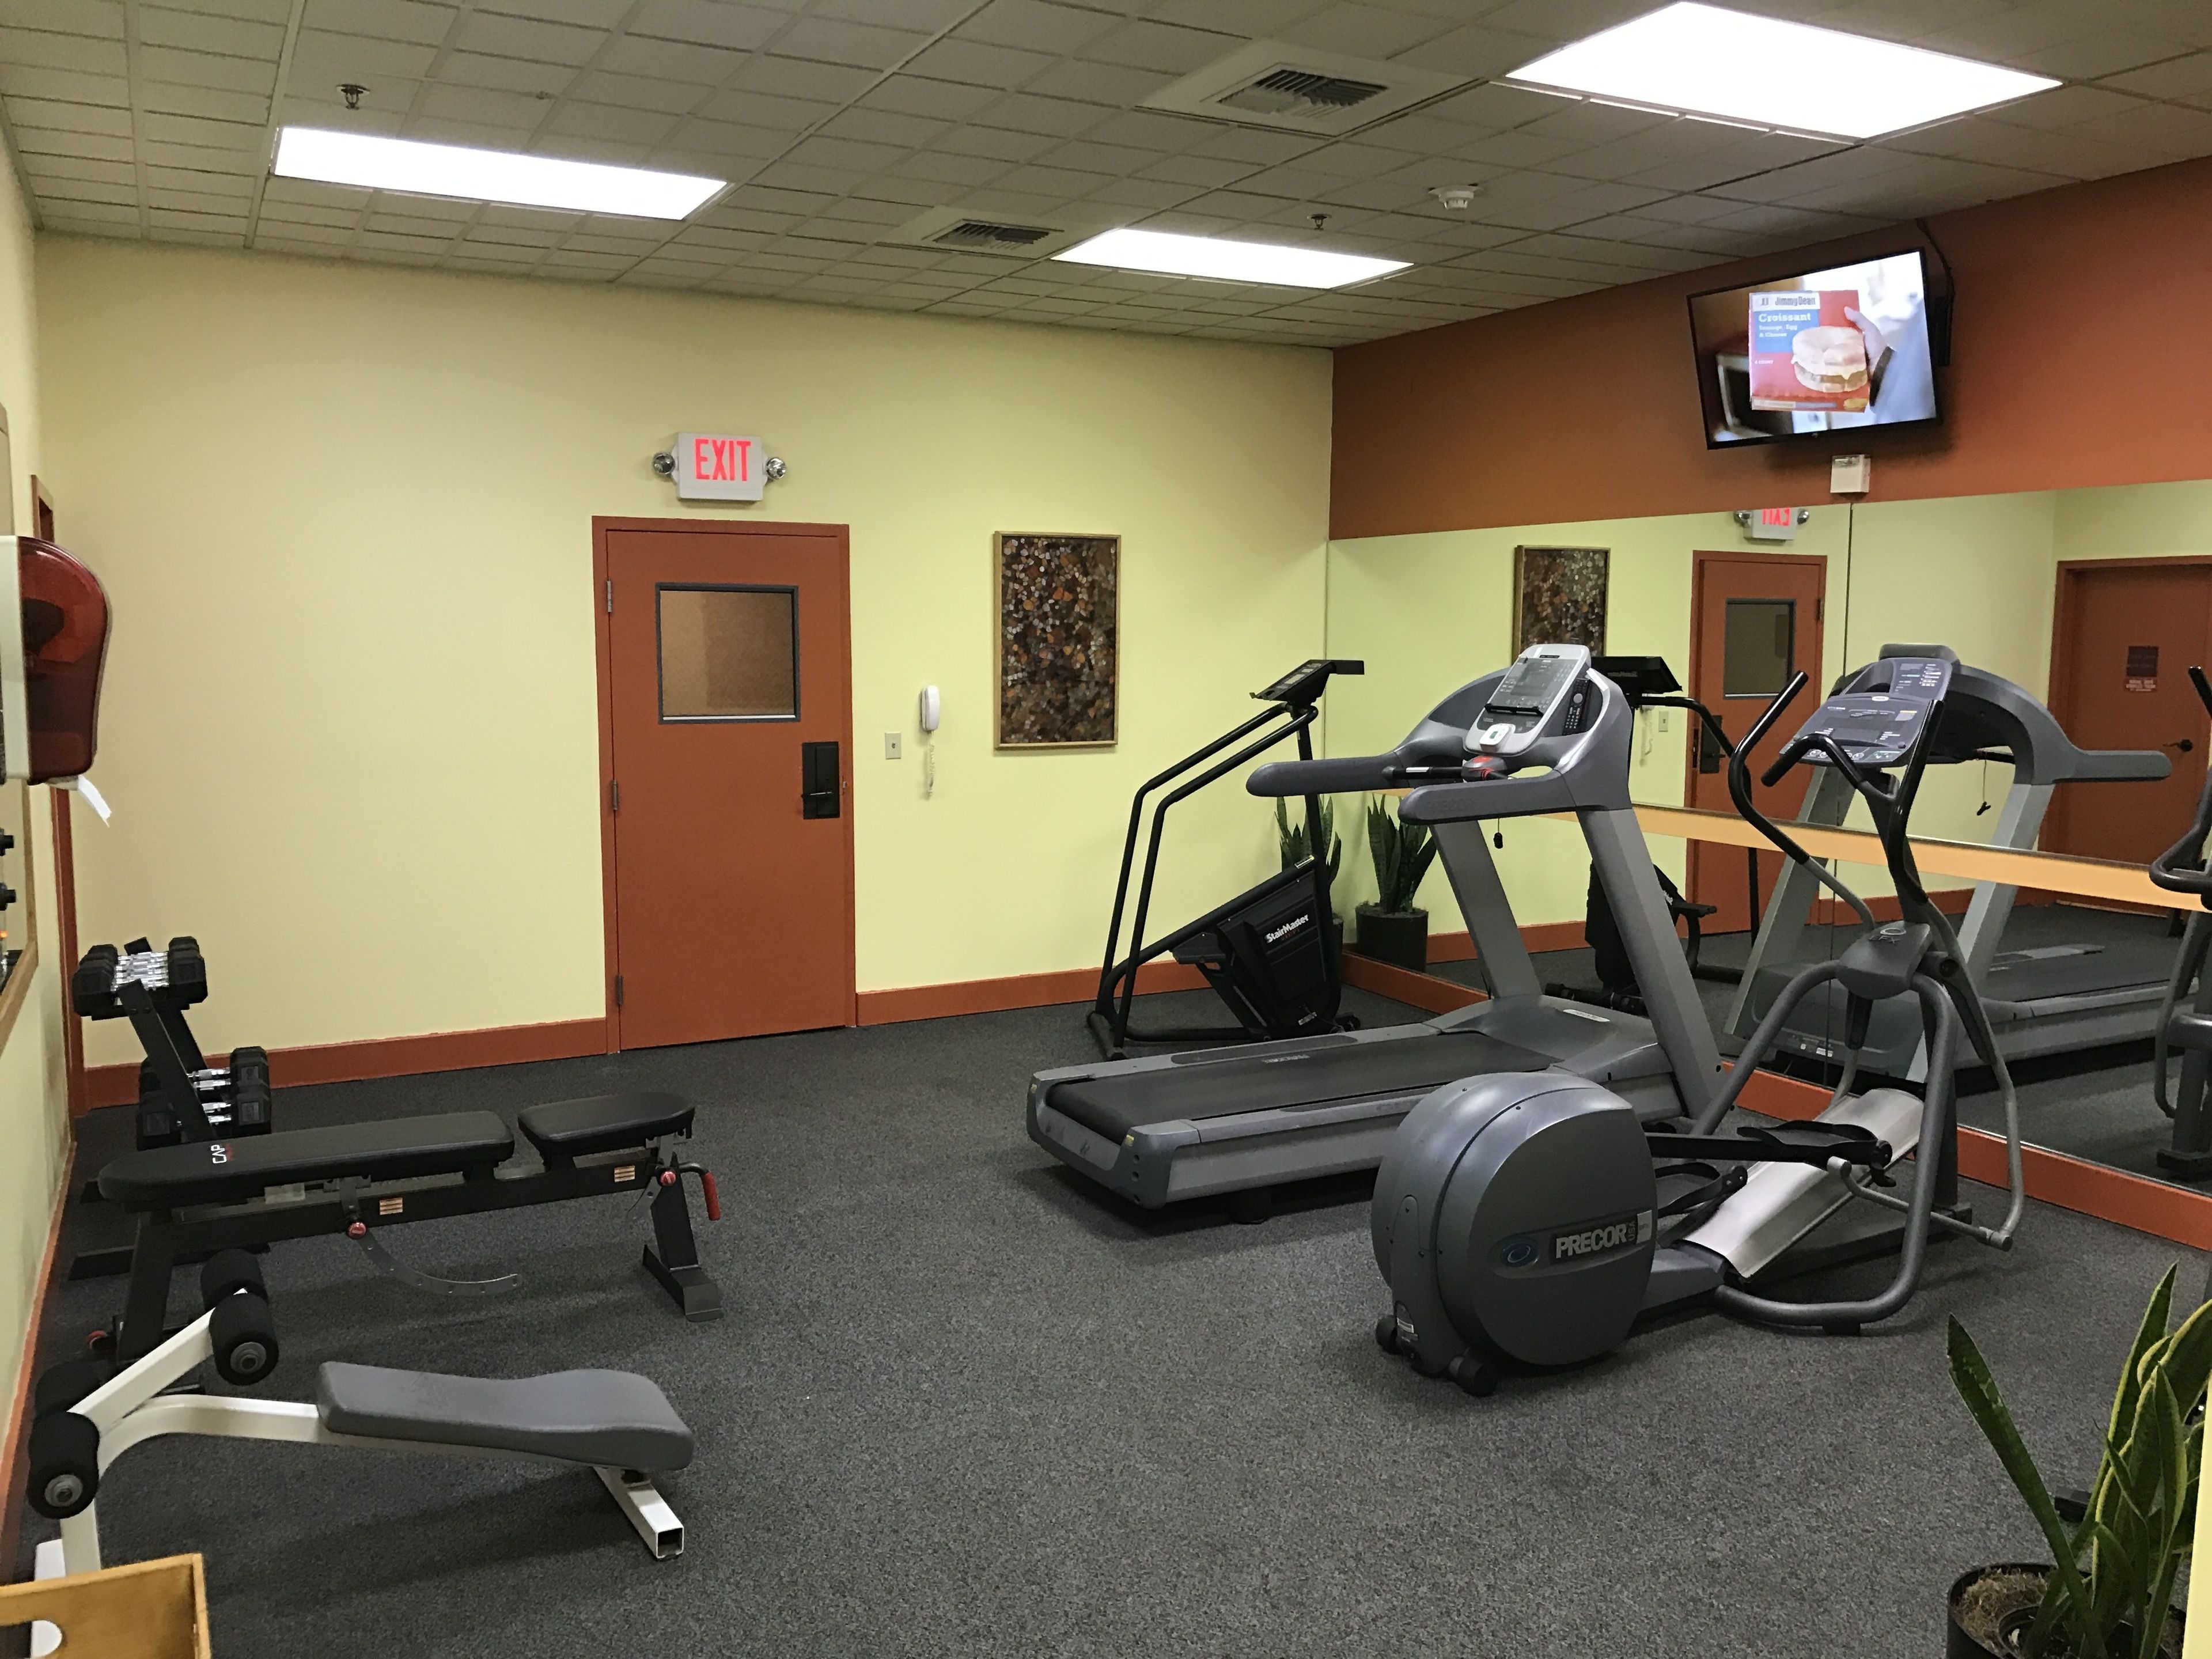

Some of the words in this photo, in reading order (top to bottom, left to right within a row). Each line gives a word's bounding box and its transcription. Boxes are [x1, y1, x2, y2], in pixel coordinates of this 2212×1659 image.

[1758, 313, 1812, 322] Croissant
[695, 438, 751, 482] EXIT
[1264, 914, 1309, 944] StairMaster
[211, 1144, 227, 1164] CAP
[1556, 1224, 1627, 1259] PRECOR
